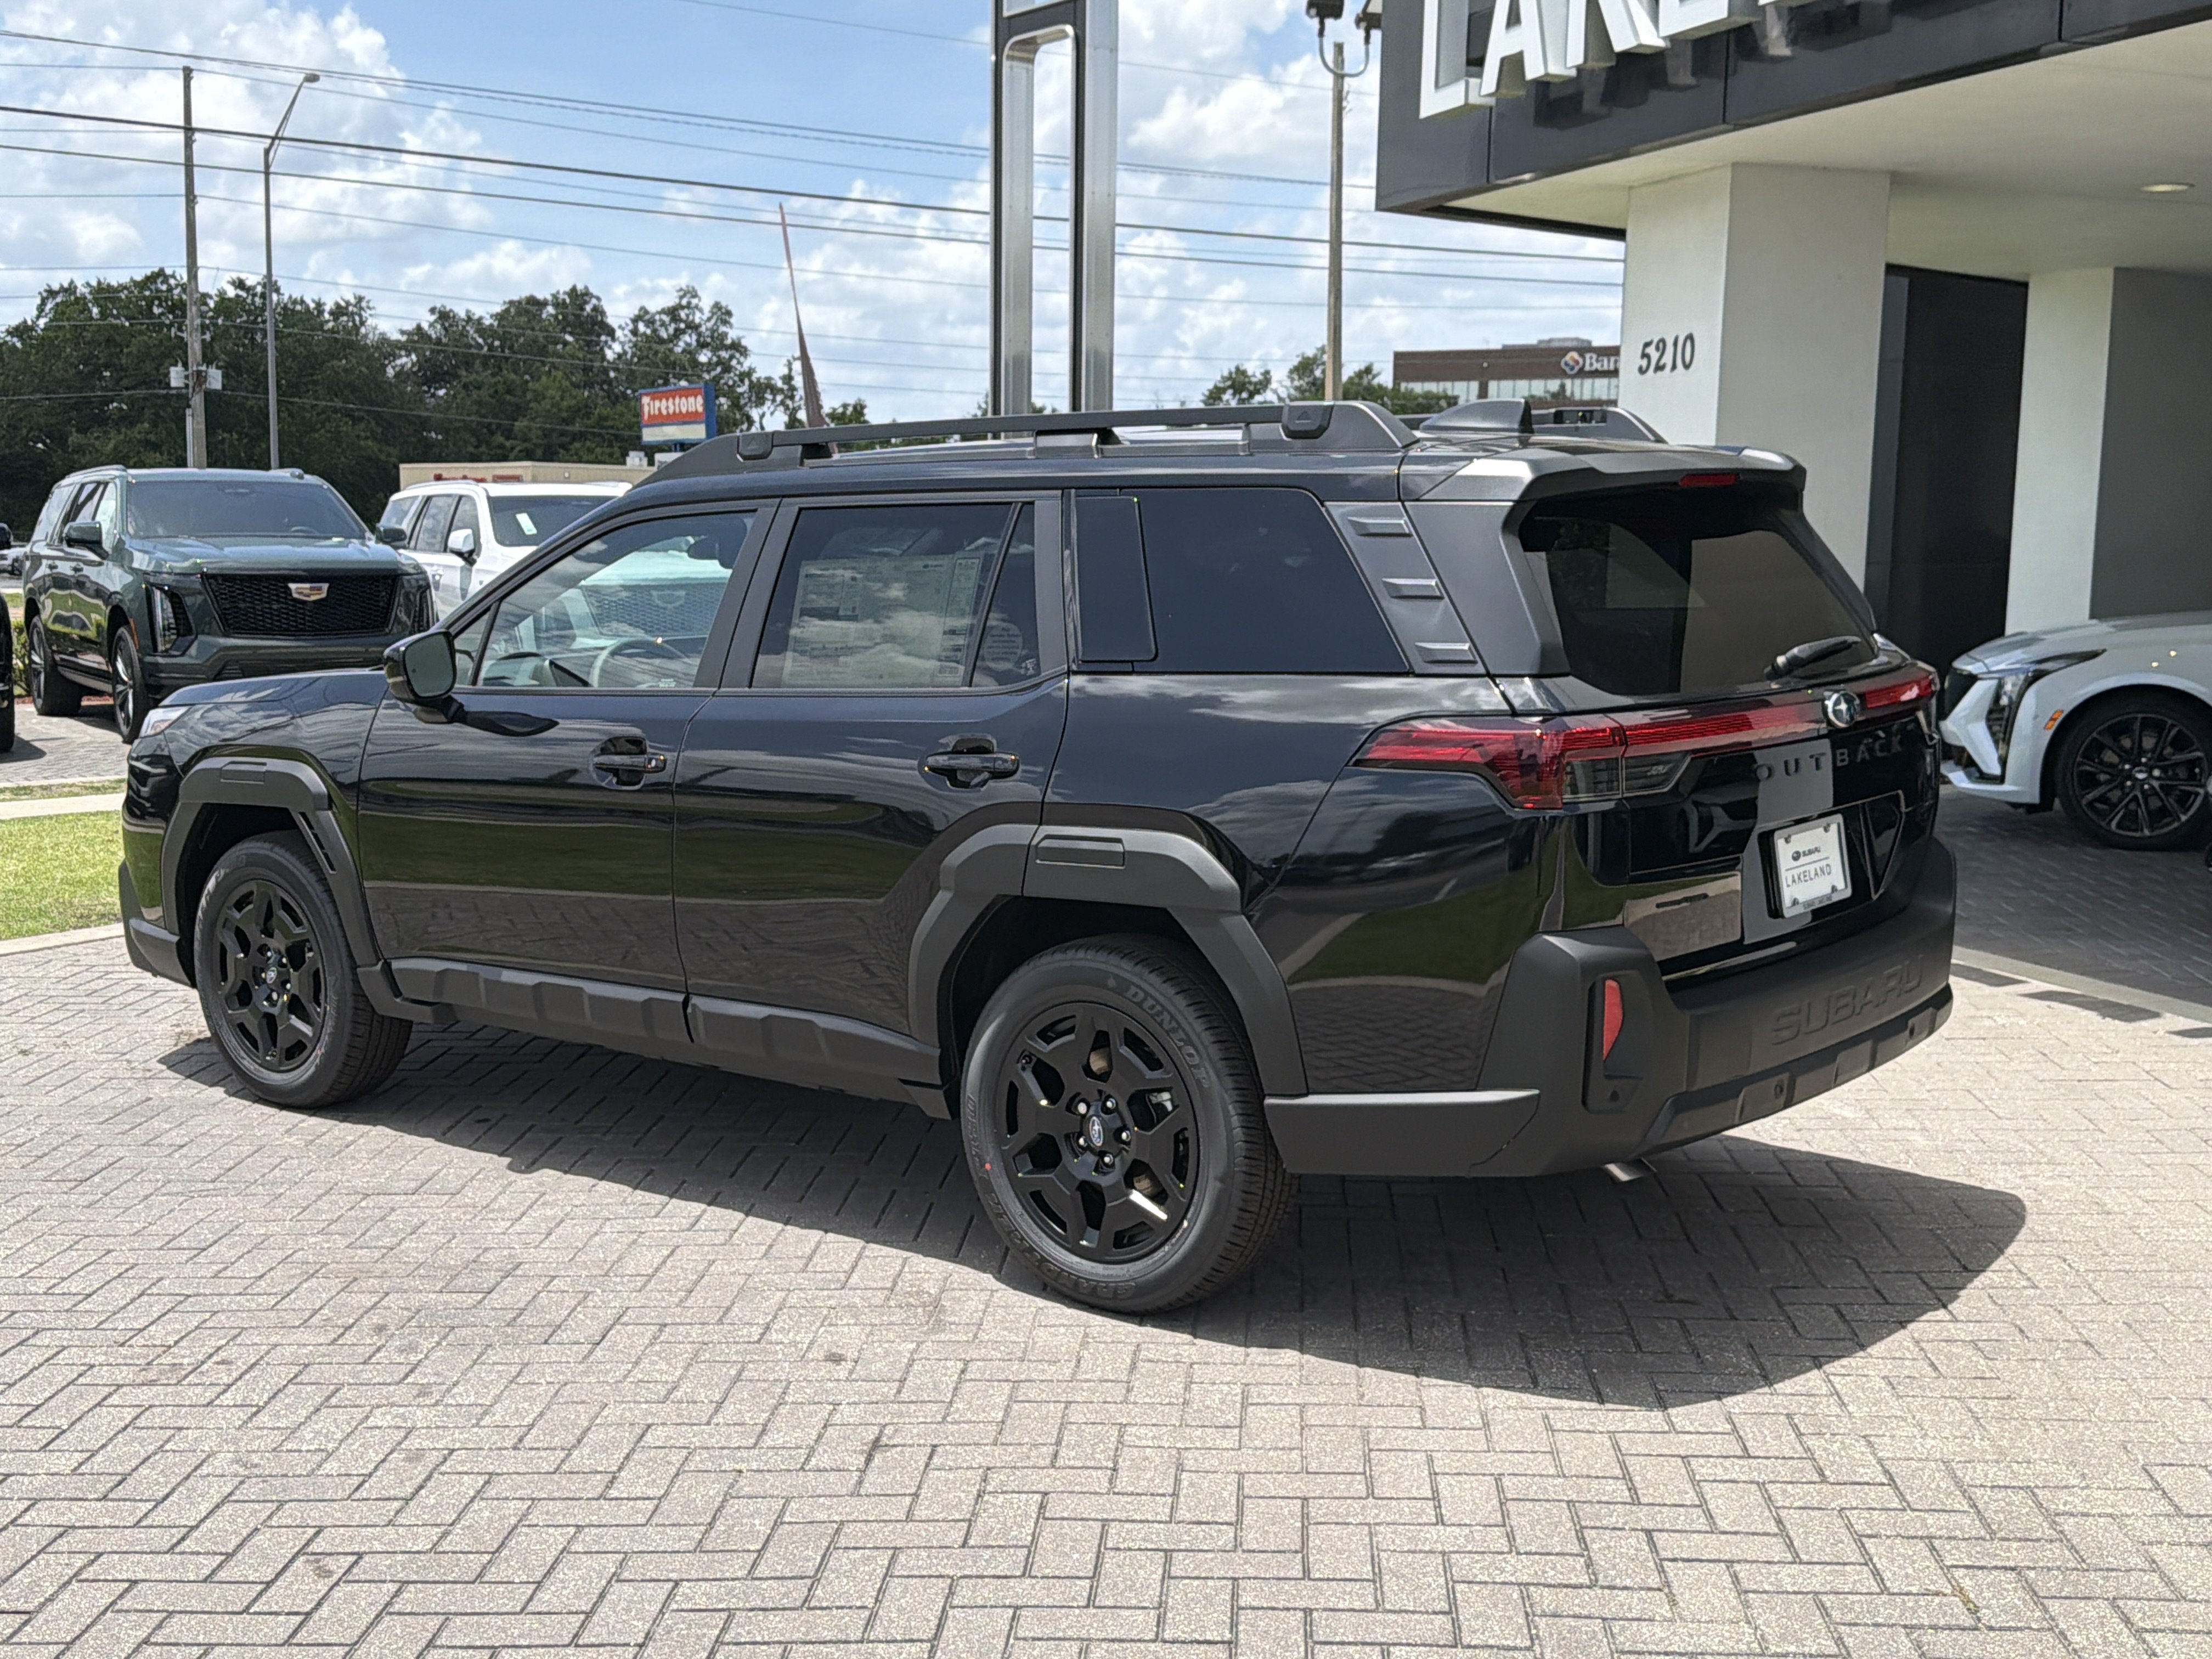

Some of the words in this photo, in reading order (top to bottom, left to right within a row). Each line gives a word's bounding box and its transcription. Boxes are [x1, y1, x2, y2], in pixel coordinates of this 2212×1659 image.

[1638, 332, 1695, 375] 5210
[641, 394, 704, 421] Firestone
[1753, 734, 1902, 781] OUTBACK
[1785, 864, 1832, 888] LAKELAND
[1772, 956, 1923, 1046] SUBARU
[1126, 985, 1210, 1088] DUNLOP
